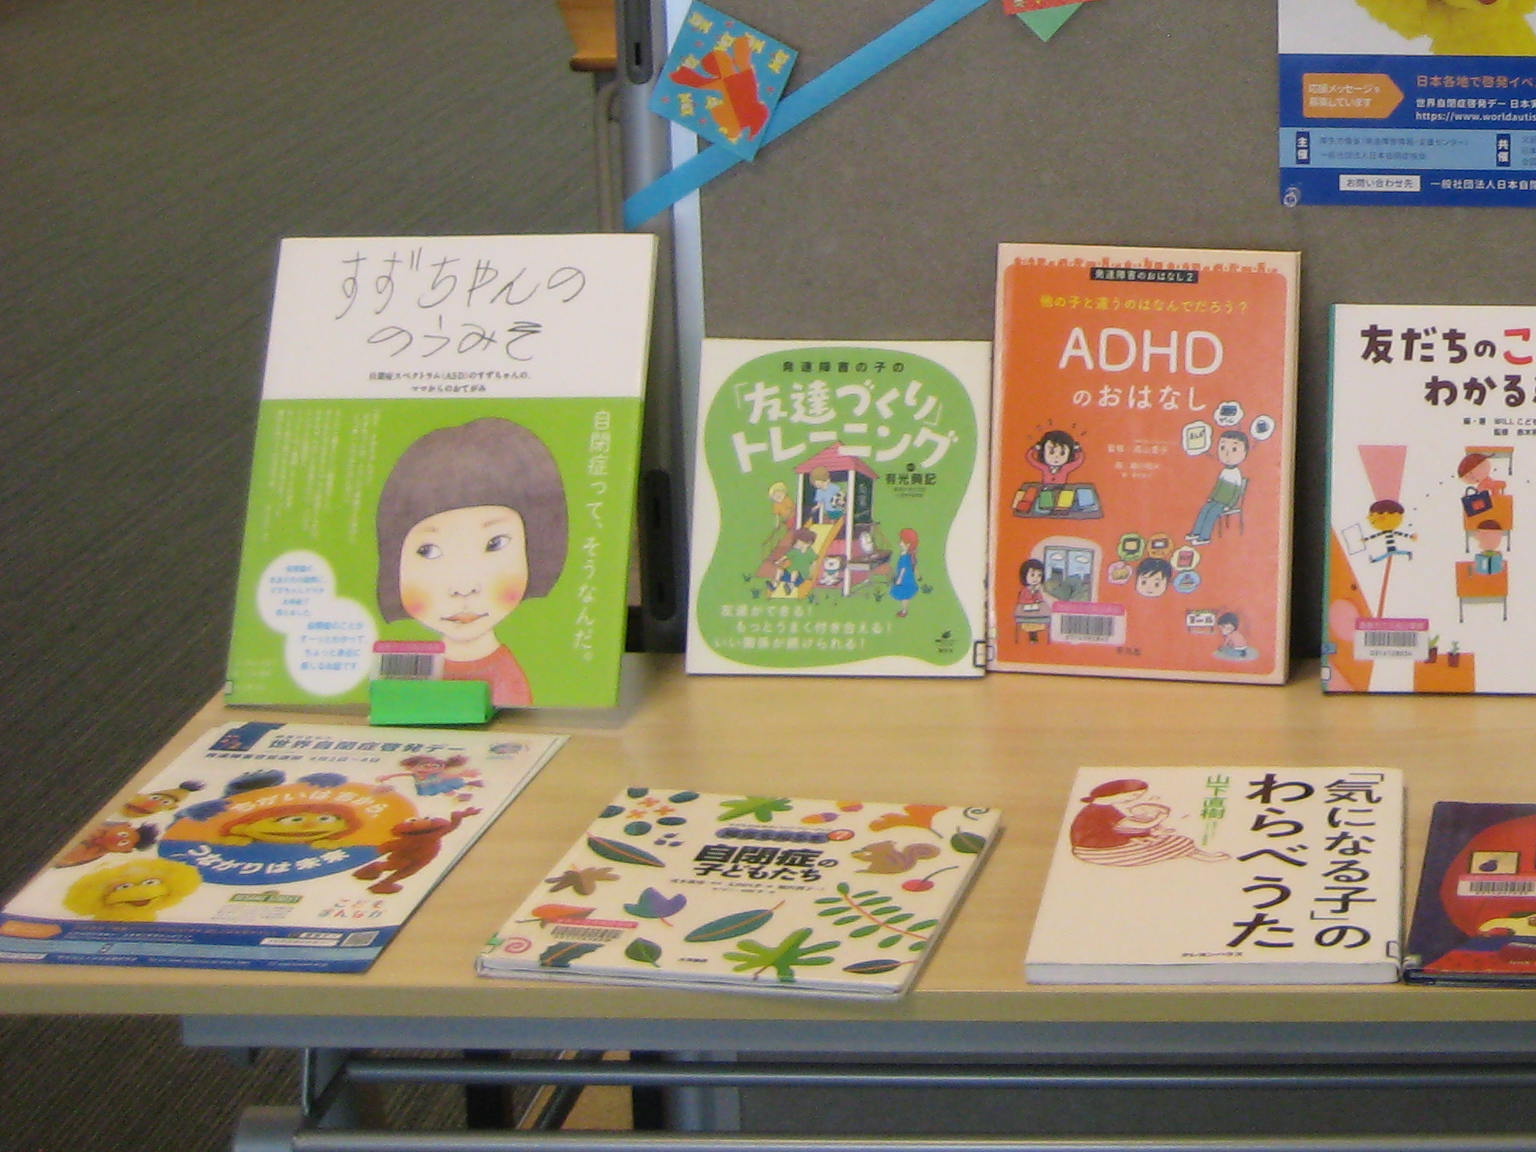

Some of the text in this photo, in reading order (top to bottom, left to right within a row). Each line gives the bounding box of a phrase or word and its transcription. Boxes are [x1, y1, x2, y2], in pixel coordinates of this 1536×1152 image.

[334, 247, 586, 321] すずちゃんの
[366, 314, 544, 361] のうみそ
[1058, 327, 1225, 375] ADHD
[1072, 384, 1208, 411] のおはなし
[732, 423, 960, 473] トレーニング
[693, 843, 839, 868] 自閉症の
[693, 862, 823, 882] 子どもたち
[1226, 773, 1315, 948] わらべうた
